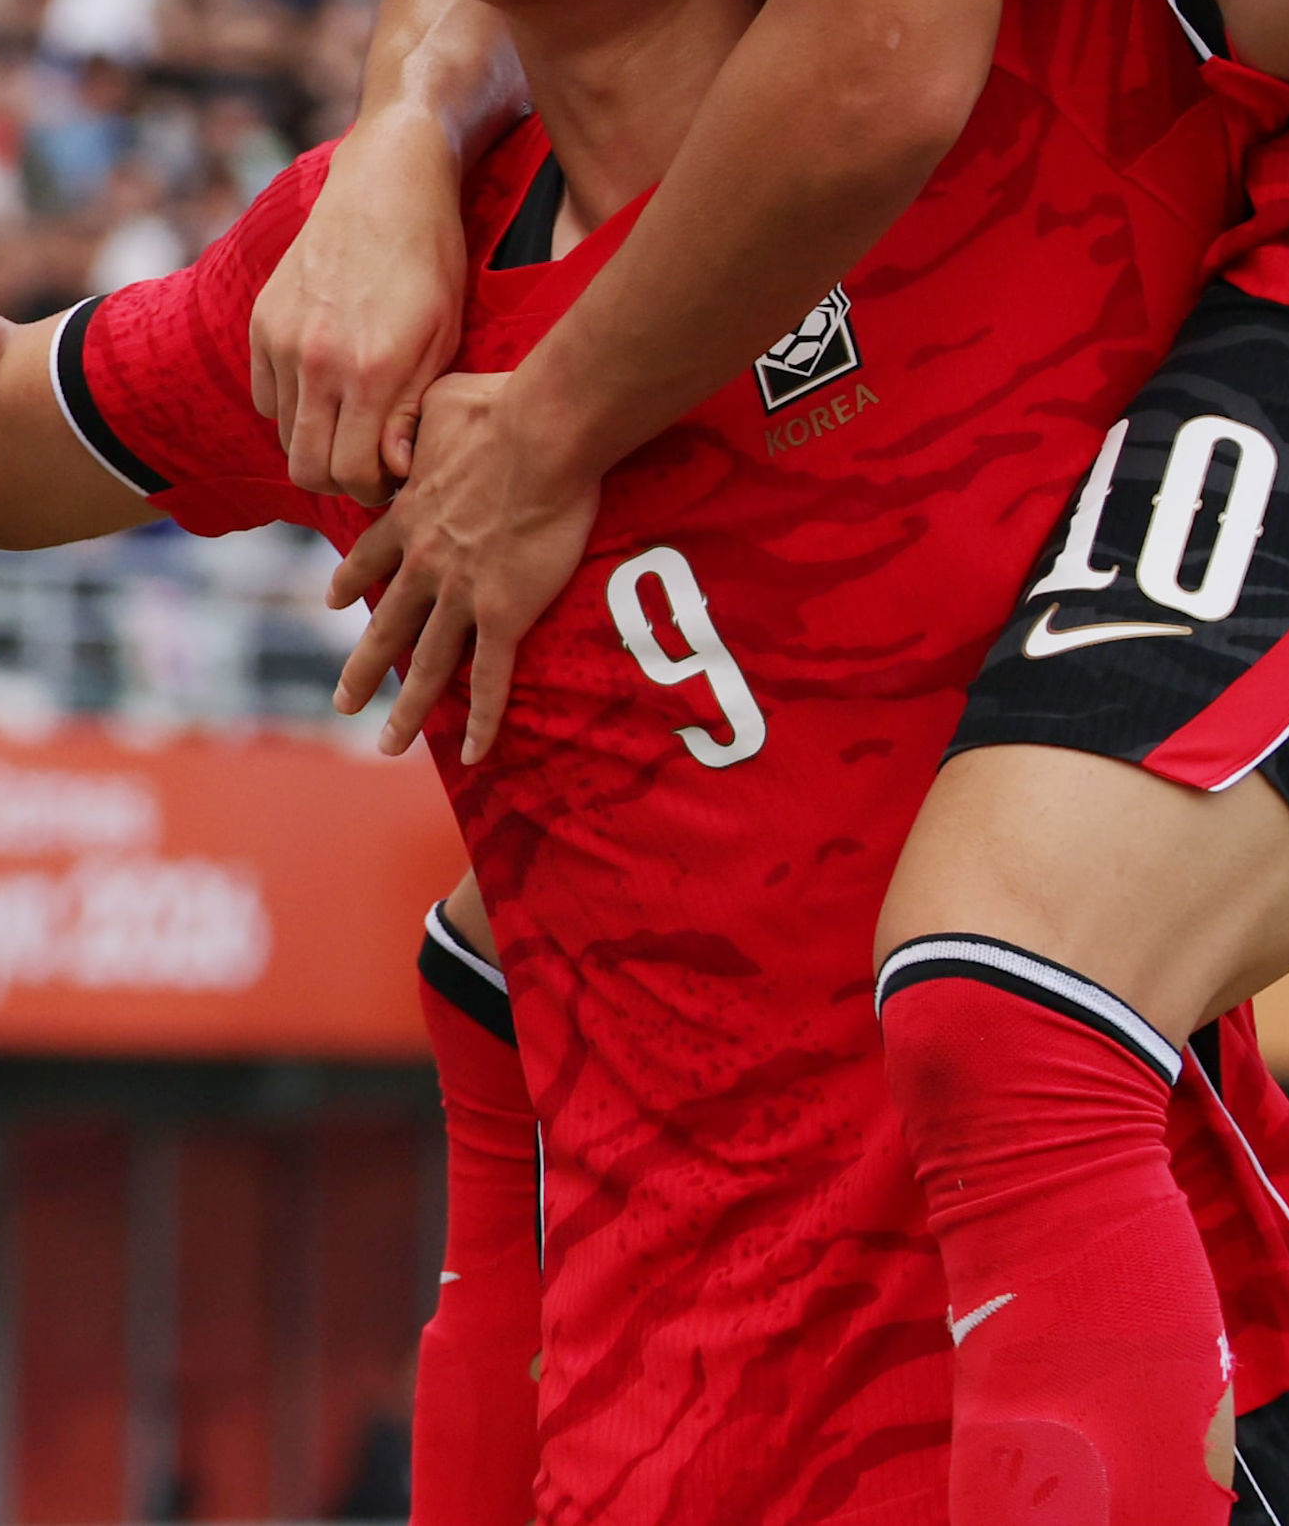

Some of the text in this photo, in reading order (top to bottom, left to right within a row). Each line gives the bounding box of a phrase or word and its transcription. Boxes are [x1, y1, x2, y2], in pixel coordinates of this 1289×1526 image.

[764, 382, 880, 457] KOREA
[1024, 414, 1278, 622] 10
[606, 543, 767, 768] 9
